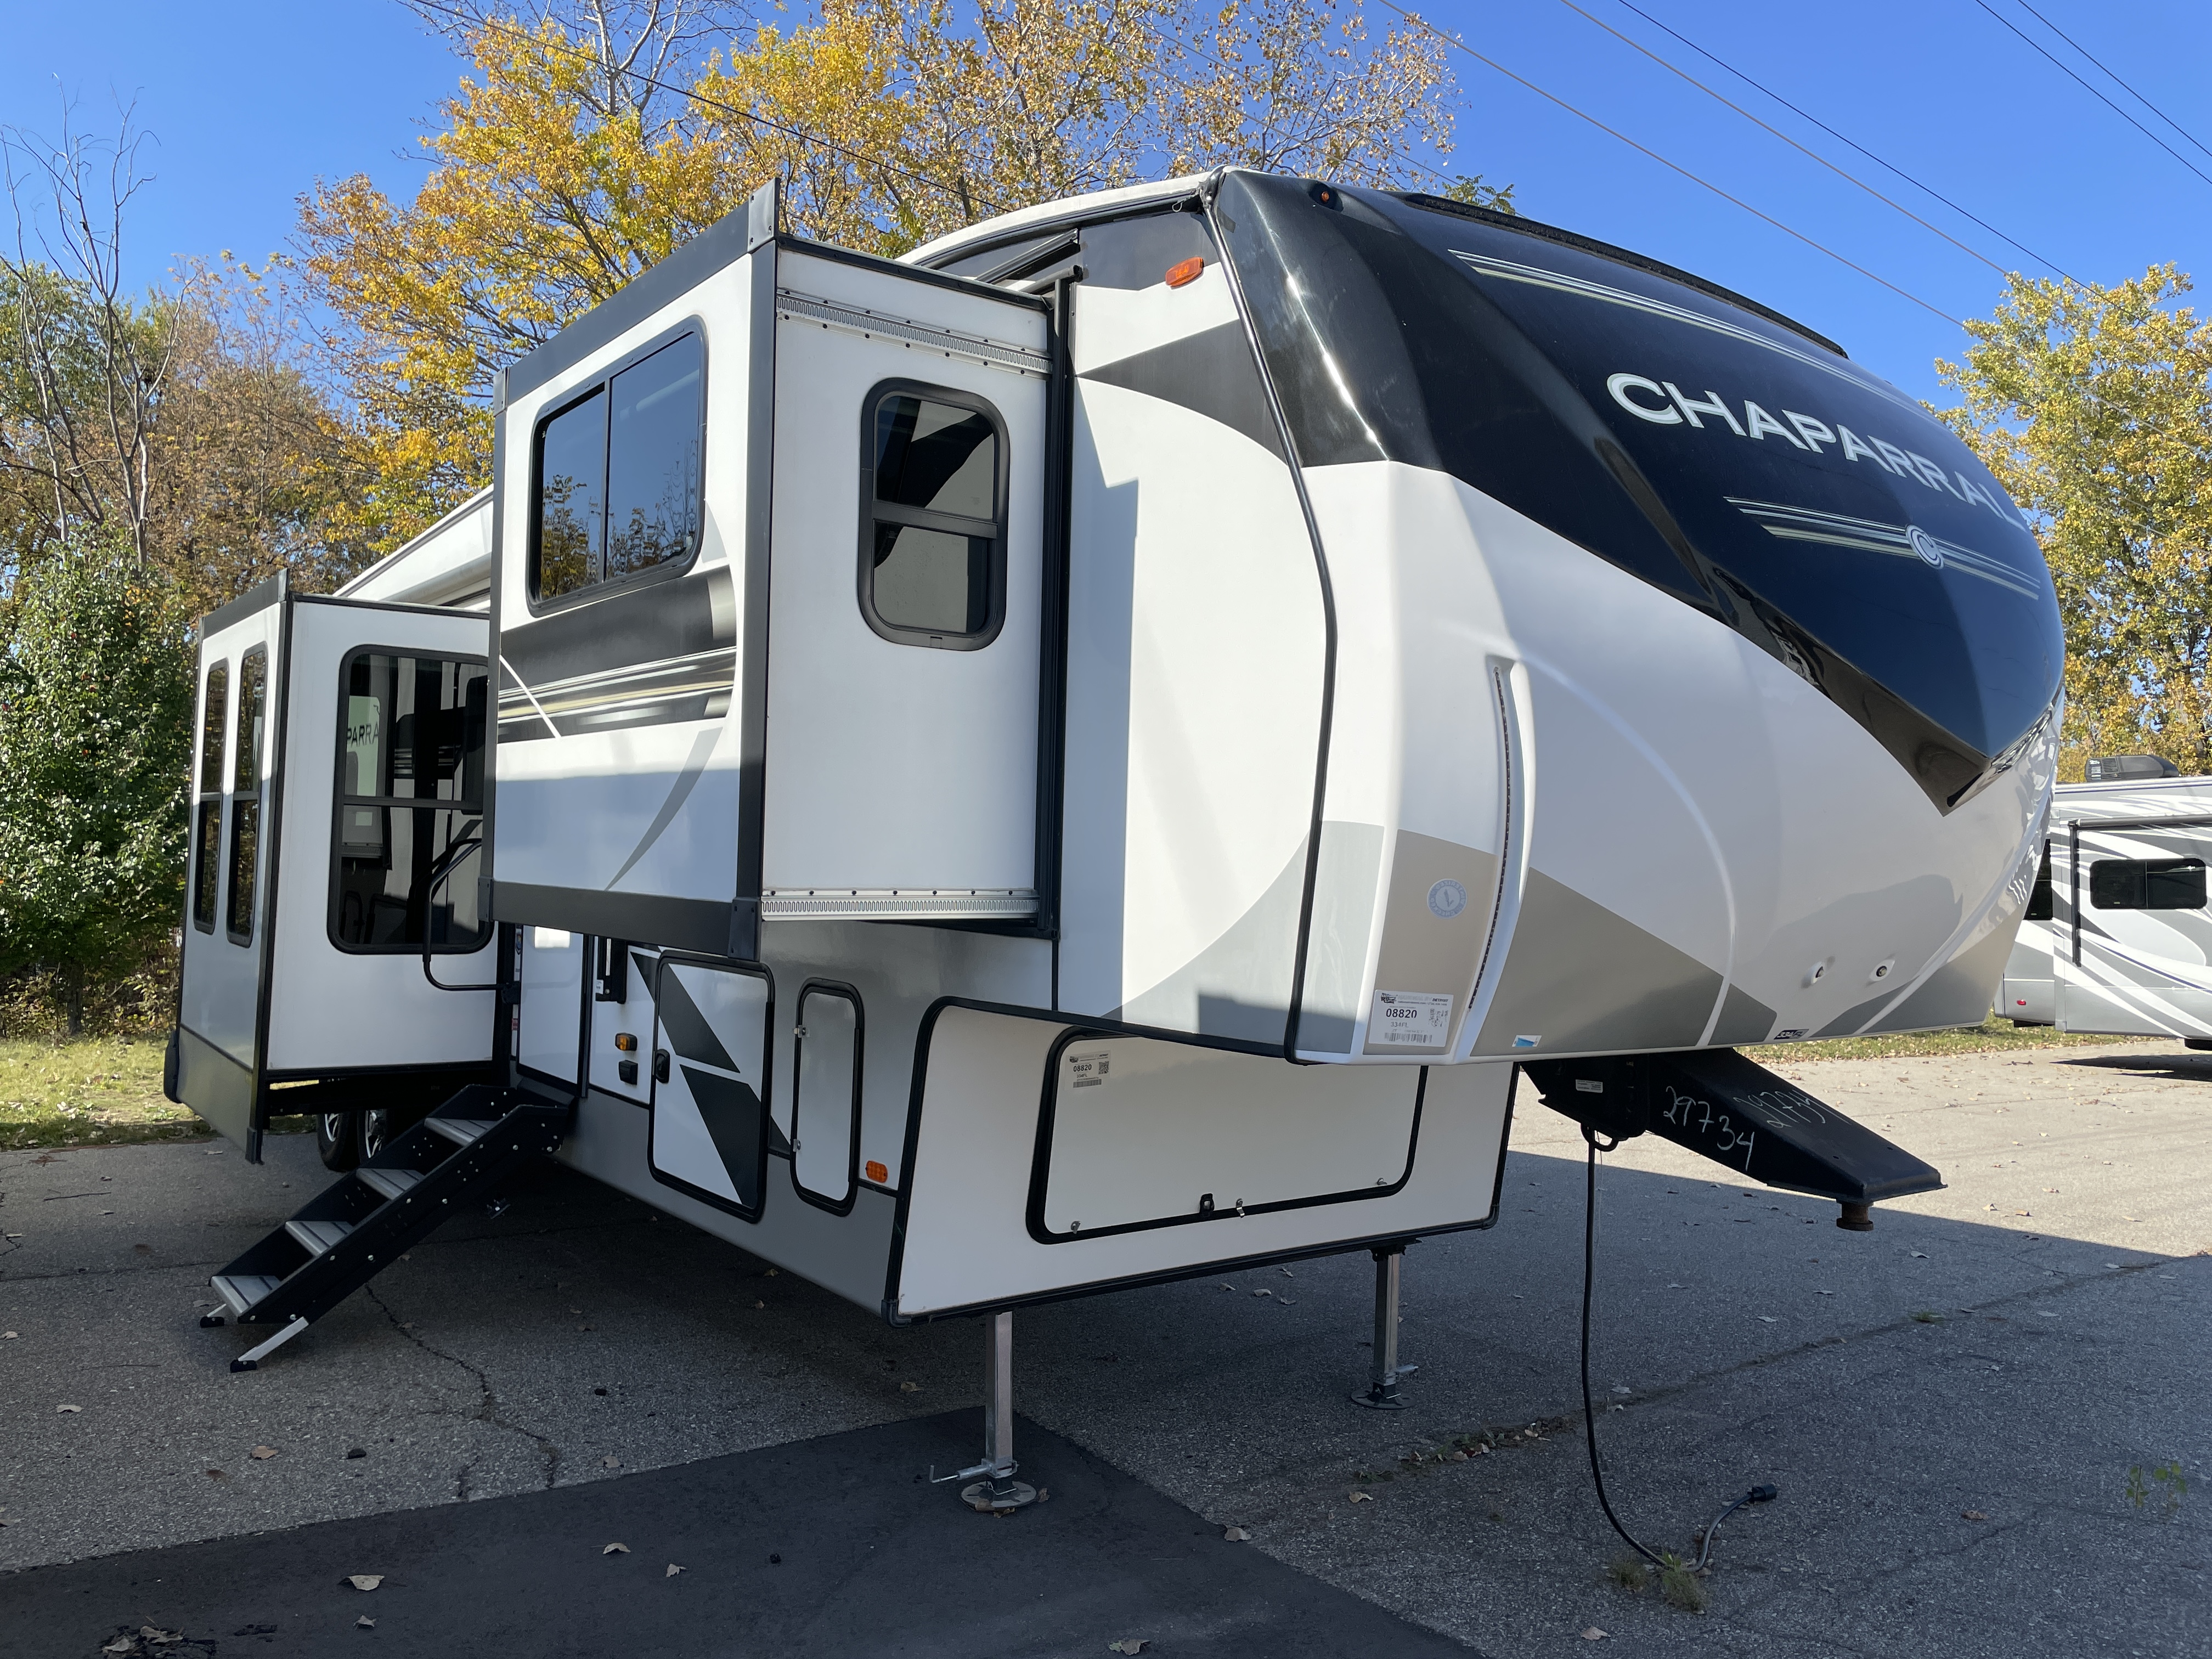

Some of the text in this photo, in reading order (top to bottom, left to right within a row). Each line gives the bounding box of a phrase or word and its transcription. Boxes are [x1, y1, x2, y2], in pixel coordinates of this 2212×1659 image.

[1606, 372, 2028, 533] CHAPARRAL
[1386, 1008, 1417, 1018] 08820
[1073, 1064, 1092, 1072] 08820
[1663, 1086, 1755, 1171] 29734
